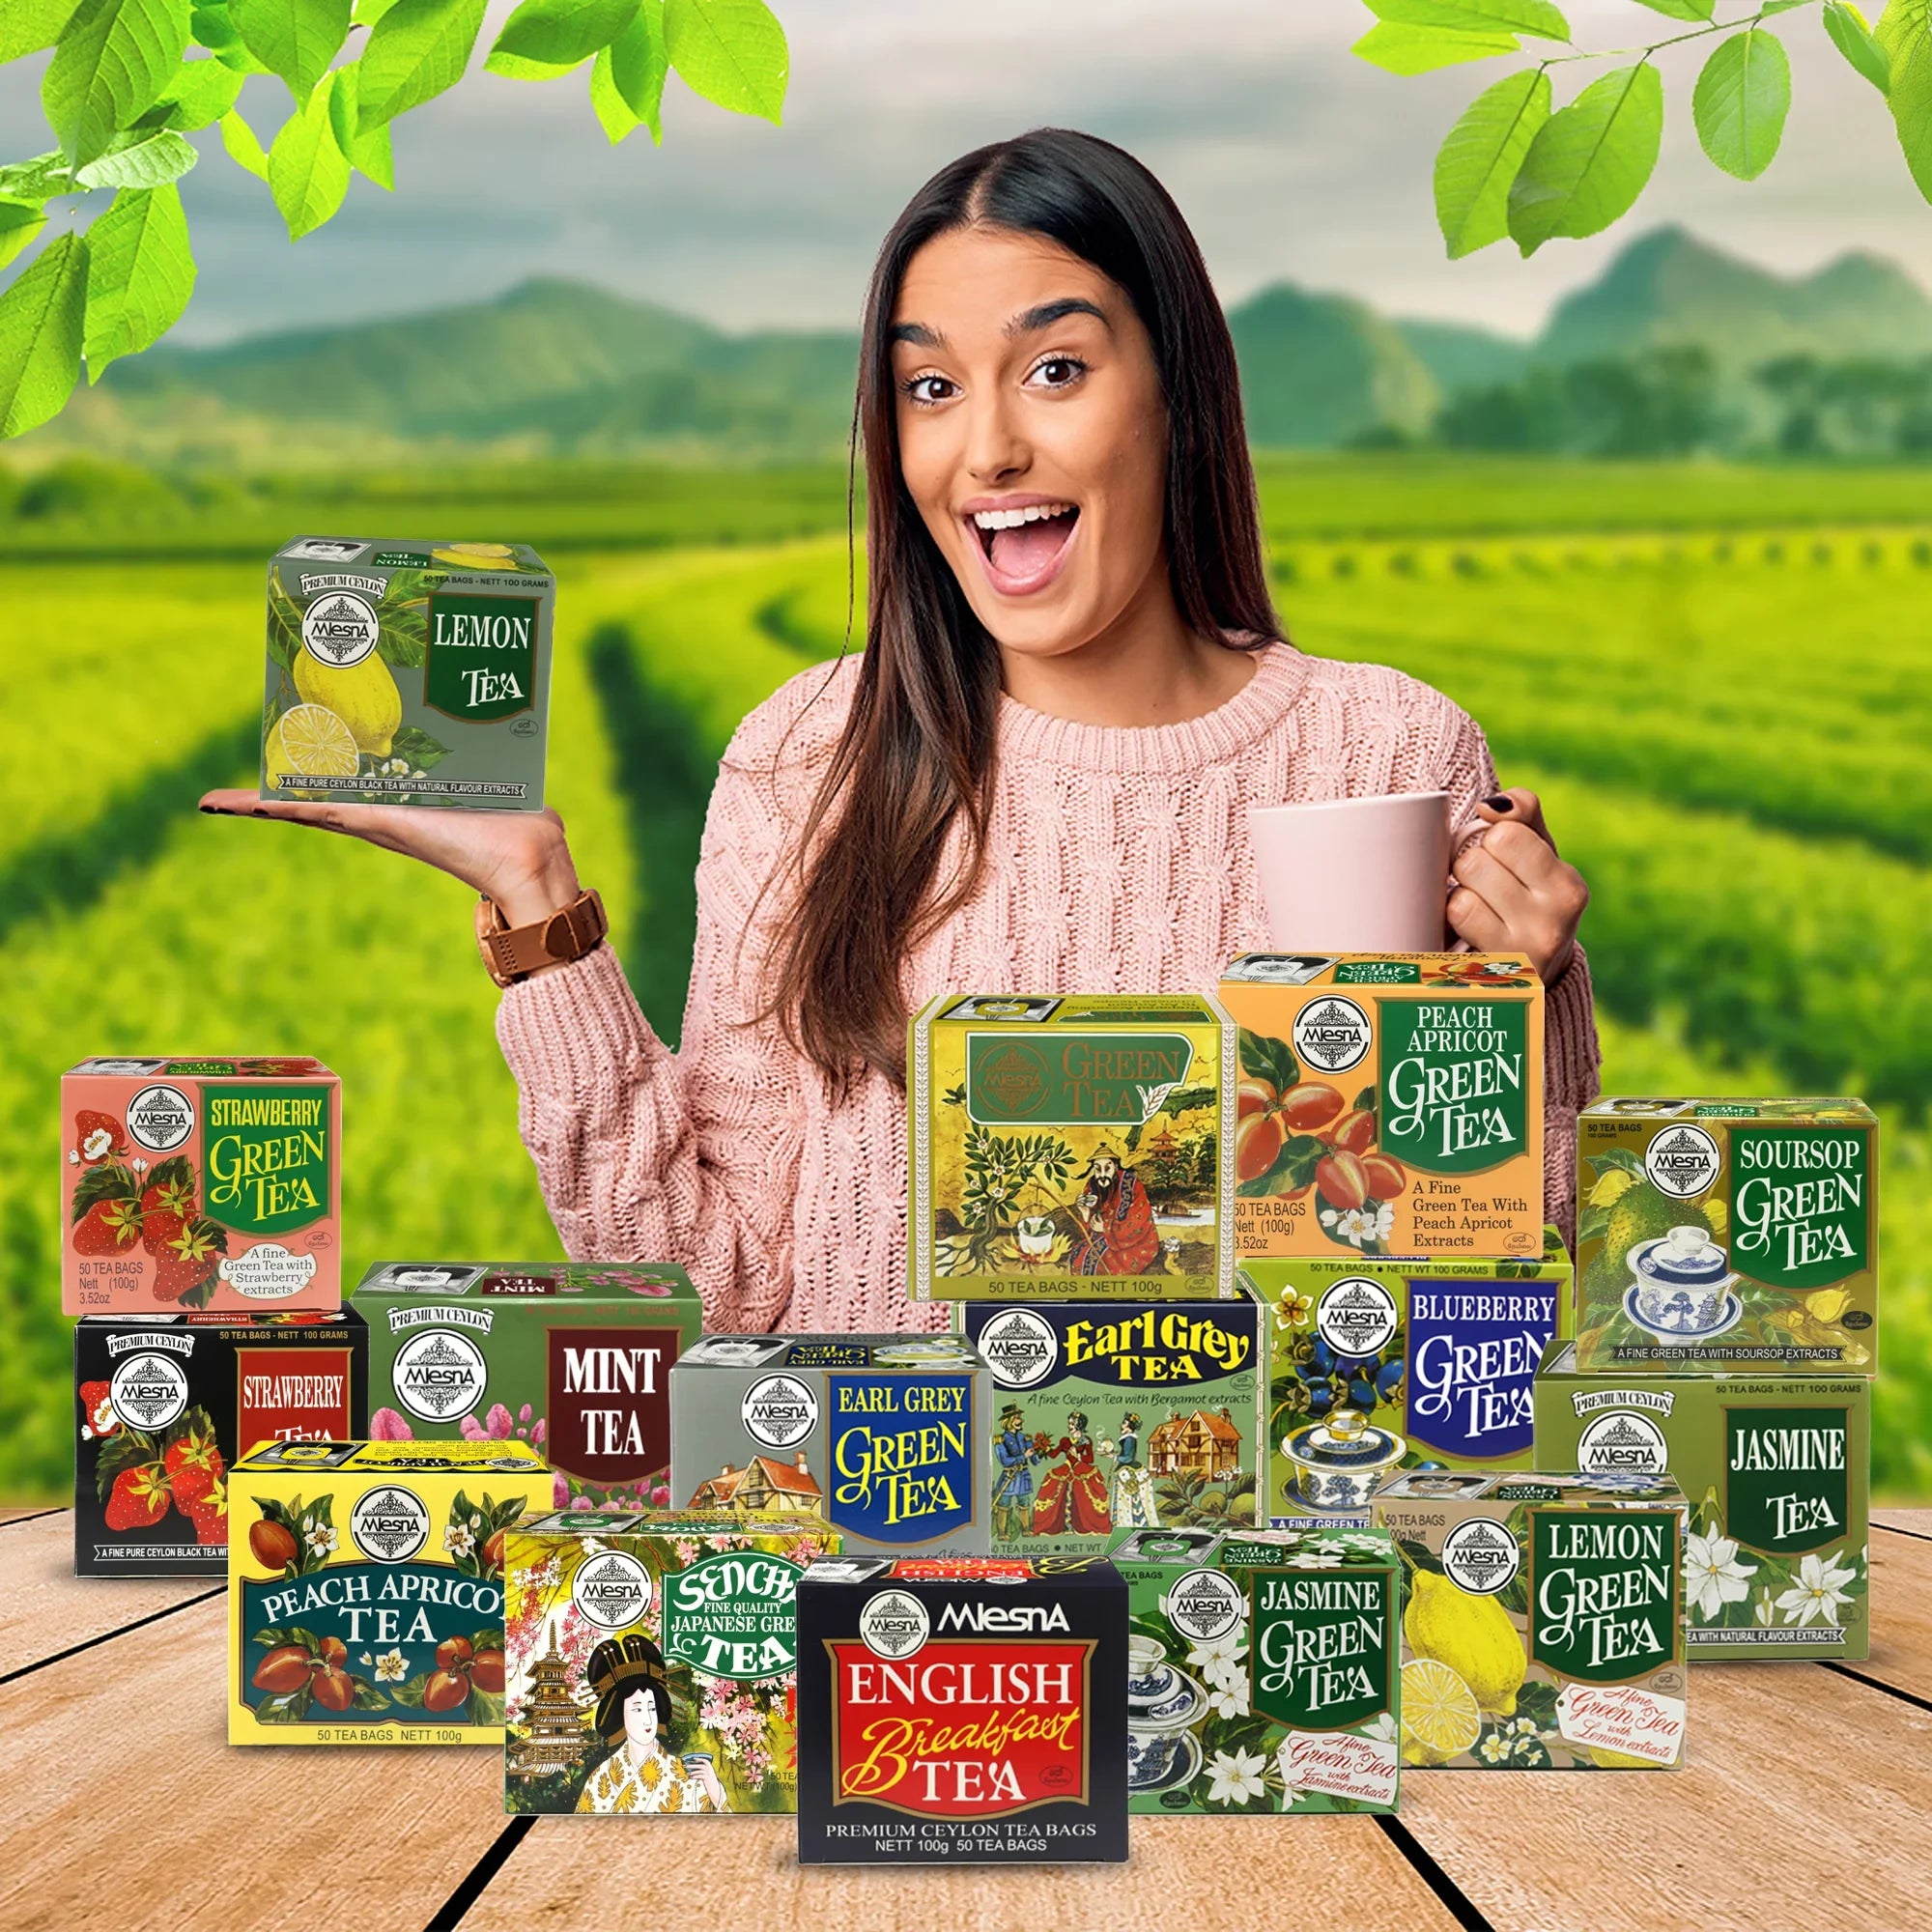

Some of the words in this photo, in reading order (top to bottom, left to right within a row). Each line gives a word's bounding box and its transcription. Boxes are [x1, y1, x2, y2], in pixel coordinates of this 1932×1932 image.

[304, 576, 347, 590] PREMIUM
[348, 576, 384, 593] CEYLON
[435, 613, 531, 649] LEMON
[462, 668, 525, 707] TEA
[399, 781, 416, 790] WITH
[418, 782, 448, 792] NATURAL
[451, 784, 481, 793] FLAVOUR
[484, 785, 520, 795] EXTRACTS
[1417, 1007, 1492, 1029] PEACH
[1406, 1031, 1507, 1052] APRICOT
[1064, 1042, 1179, 1080] GREEN
[1065, 1081, 1136, 1118] TEA
[1388, 1053, 1522, 1142] GREEN
[212, 1099, 322, 1126] STRAWBERRY
[1430, 1103, 1517, 1157] TEA
[1588, 1123, 1597, 1132] 50
[1600, 1123, 1616, 1132] TEA
[1619, 1123, 1641, 1132] BAGS
[210, 1129, 325, 1208] GREEN
[1741, 1140, 1859, 1169] SOURSOP
[245, 1176, 321, 1221] TEA
[1412, 1182, 1424, 1194] A
[1430, 1180, 1461, 1194] Fine
[1412, 1200, 1457, 1211] Green
[1462, 1200, 1487, 1211] Tea
[1492, 1199, 1527, 1211] With
[1737, 1172, 1862, 1257] GREEN
[1412, 1217, 1457, 1229] Peach
[1462, 1217, 1513, 1232] Apricot
[251, 1249, 259, 1258] A
[263, 1248, 286, 1258] fine
[1412, 1235, 1474, 1247] Extracts
[1775, 1220, 1858, 1271] TEA
[79, 1264, 90, 1274] 50
[95, 1263, 112, 1273] TEA
[115, 1262, 143, 1273] BAGS
[224, 1262, 261, 1271] Green
[260, 1261, 282, 1270] Tea
[286, 1260, 312, 1270] with
[236, 1272, 302, 1287] Strawberry
[1311, 1264, 1321, 1272] 50
[1323, 1264, 1342, 1272] TEA
[1387, 1264, 1412, 1273] NETT
[1434, 1265, 1450, 1274] 100
[1453, 1265, 1488, 1274] GRAMS
[79, 1278, 98, 1290] Nett
[108, 1277, 138, 1291] (100g)
[79, 1293, 110, 1304] 3.52oz
[243, 1285, 293, 1294] extracts
[988, 1282, 1004, 1293] 50
[1008, 1282, 1036, 1293] TEA
[1039, 1282, 1077, 1293] BAGS
[1092, 1282, 1127, 1293] NETT
[1132, 1281, 1161, 1294] 100g
[391, 1309, 444, 1327] PREMIUM
[447, 1310, 491, 1329] CEYLON
[1413, 1295, 1555, 1321] BLUEBERRY
[110, 1336, 154, 1351] PREMIUM
[156, 1336, 191, 1352] CEYLON
[1063, 1310, 1155, 1366] Earl
[1160, 1314, 1249, 1370] Grey
[1618, 1349, 1625, 1357] A
[1626, 1349, 1649, 1358] FINE
[1652, 1349, 1686, 1358] GREEN
[1688, 1349, 1706, 1358] TEA
[1709, 1349, 1733, 1358] WITH
[1736, 1349, 1783, 1358] SOURSOP
[1786, 1349, 1837, 1359] EXTRACTS
[563, 1349, 661, 1394] MINT
[1111, 1354, 1202, 1380] TEA
[1415, 1330, 1553, 1422] GREEN
[243, 1376, 343, 1408] STRAWBERRY
[838, 1387, 898, 1412] EARL
[904, 1387, 966, 1412] GREY
[1028, 1394, 1037, 1404] A
[1038, 1394, 1059, 1406] fine
[1063, 1394, 1100, 1406] Ceylon
[1102, 1394, 1122, 1404] Tea
[1124, 1394, 1149, 1404] with
[1151, 1394, 1207, 1406] Bergamot
[1208, 1394, 1251, 1404] extracts
[1577, 1393, 1626, 1410] PREMIUM
[1629, 1393, 1670, 1410] CEYLON
[1457, 1378, 1533, 1438] TEA
[582, 1409, 644, 1456] TEA
[1731, 1429, 1845, 1471] JASMINE
[836, 1421, 966, 1510] GREEN
[876, 1470, 961, 1525] TEA
[1386, 1515, 1395, 1525] 50
[1399, 1515, 1416, 1525] TEA
[1419, 1515, 1445, 1526] BAGS
[1766, 1492, 1838, 1540] TEA
[1548, 1524, 1662, 1559] LEMON
[261, 1575, 371, 1624] PEACH
[377, 1575, 505, 1620] APRICO
[703, 1602, 731, 1613] FINE
[733, 1602, 782, 1615] QUALITY
[1261, 1581, 1379, 1610] JASMINE
[1539, 1563, 1670, 1652] GREEN
[338, 1606, 438, 1642] TEA
[671, 1615, 756, 1633] JAPANESE
[700, 1634, 794, 1673] TEA
[1578, 1614, 1664, 1667] TEA
[1261, 1616, 1384, 1697] GREEN
[847, 1663, 1072, 1705] ENGLISH
[1297, 1663, 1378, 1712] TEA
[1604, 1689, 1631, 1699] A
[1621, 1690, 1653, 1706] fine
[1569, 1687, 1634, 1724] Green
[1634, 1706, 1680, 1736] Tea
[1573, 1719, 1626, 1747] Lemon
[1627, 1740, 1673, 1758] extracts
[1607, 1724, 1633, 1736] with
[841, 1707, 1079, 1796] Breakfast
[913, 1760, 1026, 1802] TEA
[826, 1825, 915, 1836] PREMIUM
[922, 1825, 1000, 1836] CEYLON
[1005, 1824, 1038, 1836] TEA
[1046, 1824, 1096, 1836] BAGS
[875, 1839, 912, 1852] NETT
[918, 1839, 949, 1854] 100g
[957, 1839, 973, 1852] 50
[977, 1839, 1005, 1852] TEA
[1008, 1839, 1046, 1852] BAGS
